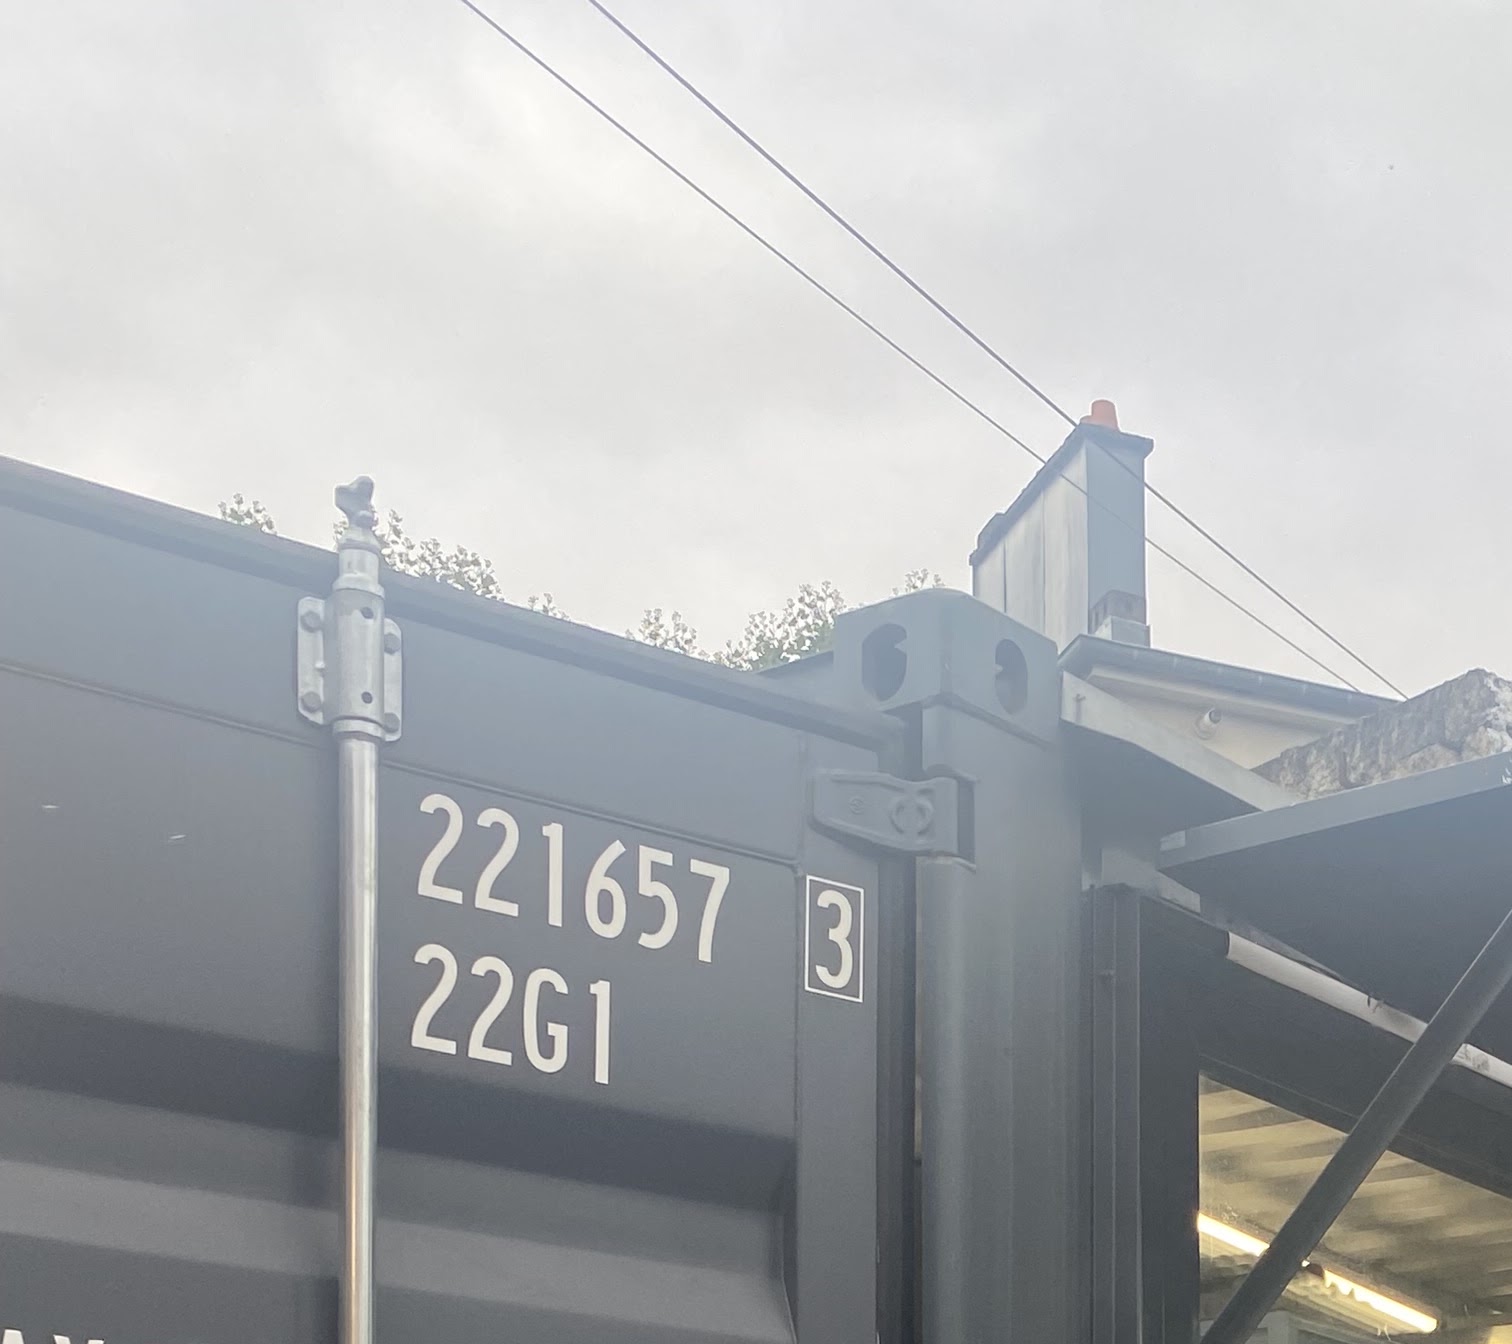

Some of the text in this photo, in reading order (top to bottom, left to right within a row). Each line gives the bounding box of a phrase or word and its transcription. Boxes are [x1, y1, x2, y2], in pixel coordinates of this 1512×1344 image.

[417, 793, 853, 989] 221657 3
[411, 943, 612, 1085] 22G1
